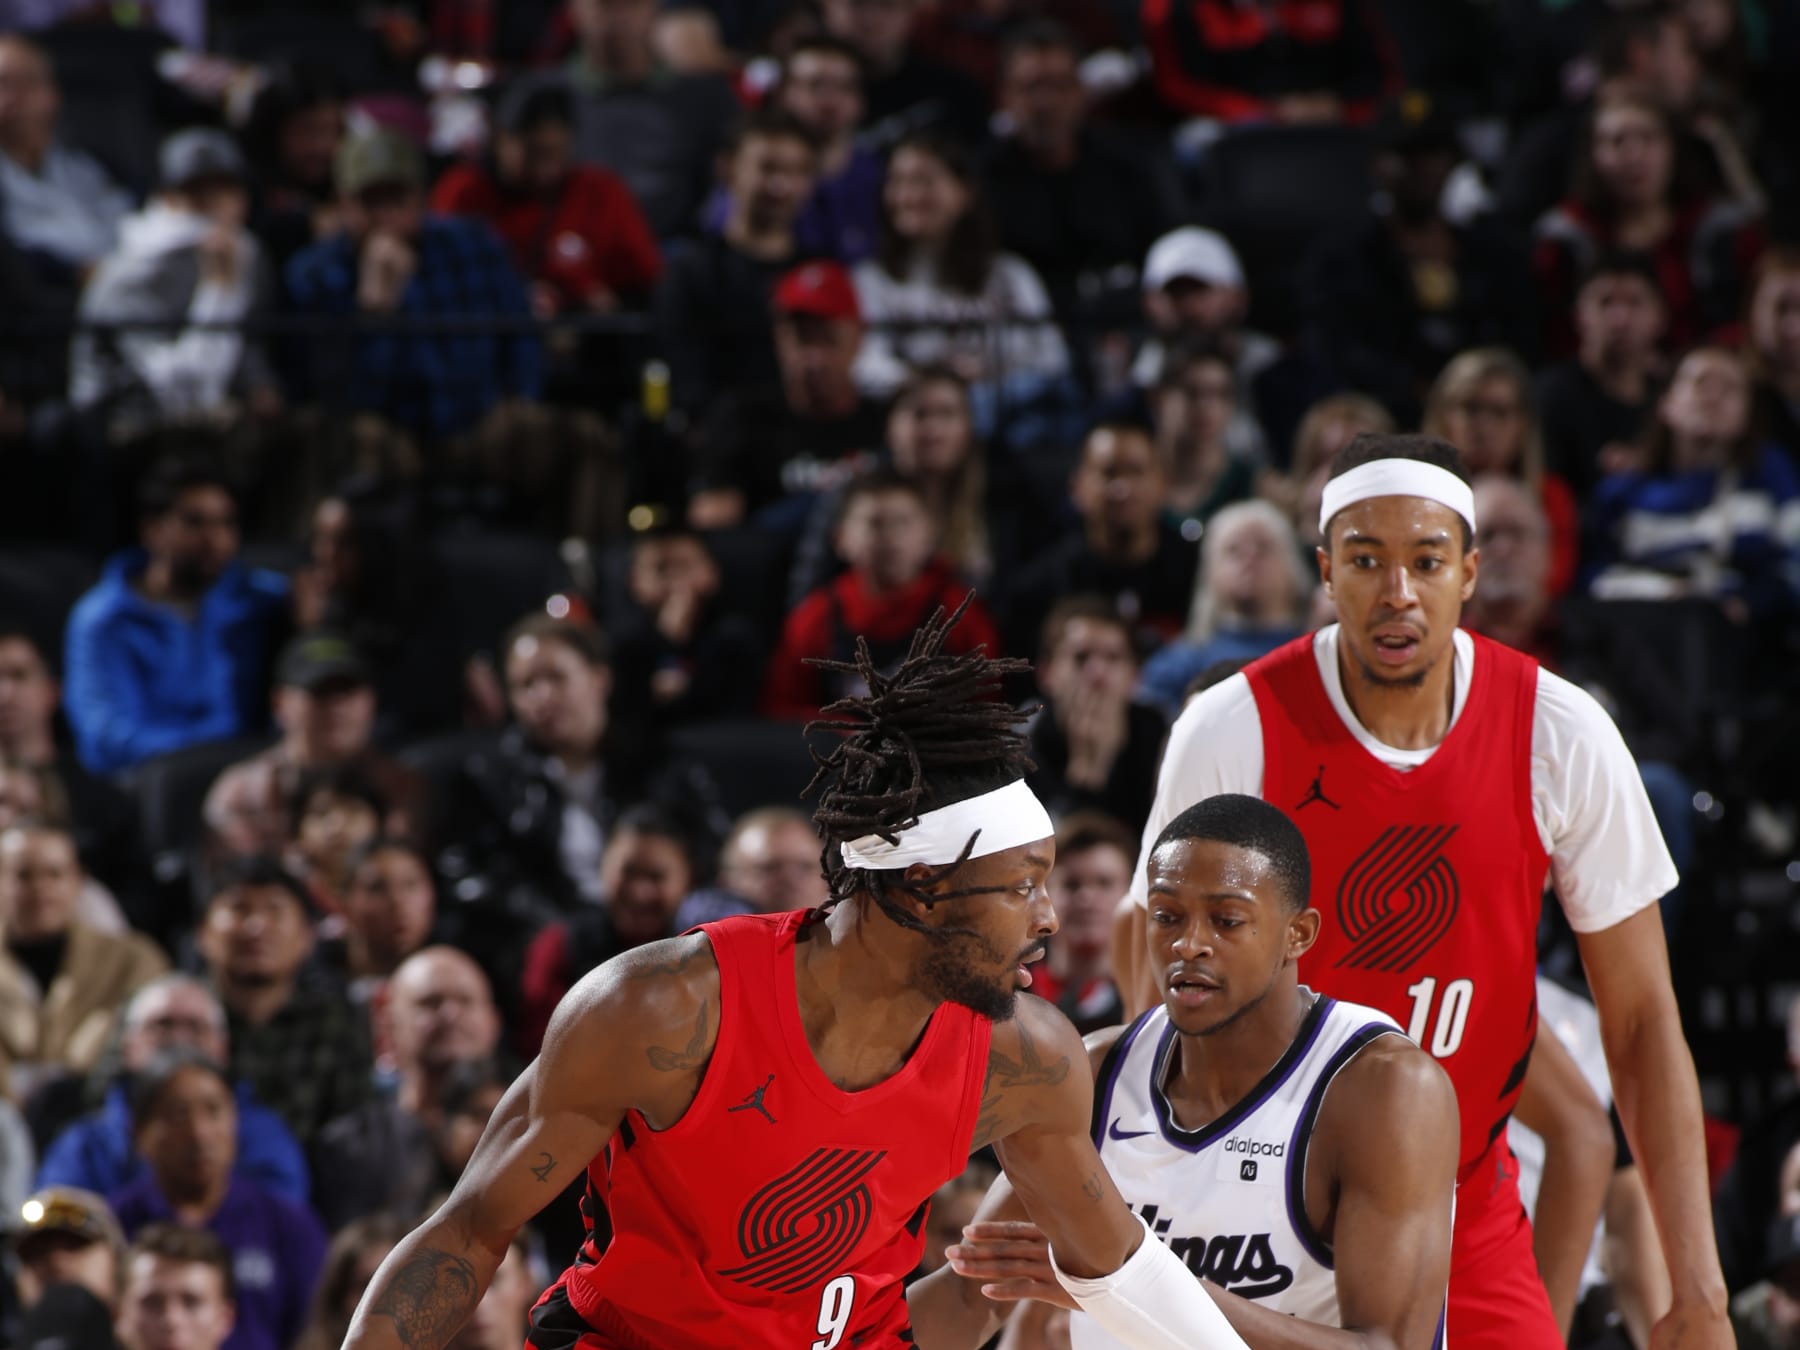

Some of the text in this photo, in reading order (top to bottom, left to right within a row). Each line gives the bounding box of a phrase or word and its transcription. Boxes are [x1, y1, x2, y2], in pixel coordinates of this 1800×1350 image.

[1407, 976, 1474, 1058] 10
[1224, 1136, 1285, 1158] dialpad
[1126, 1203, 1294, 1300] ngs
